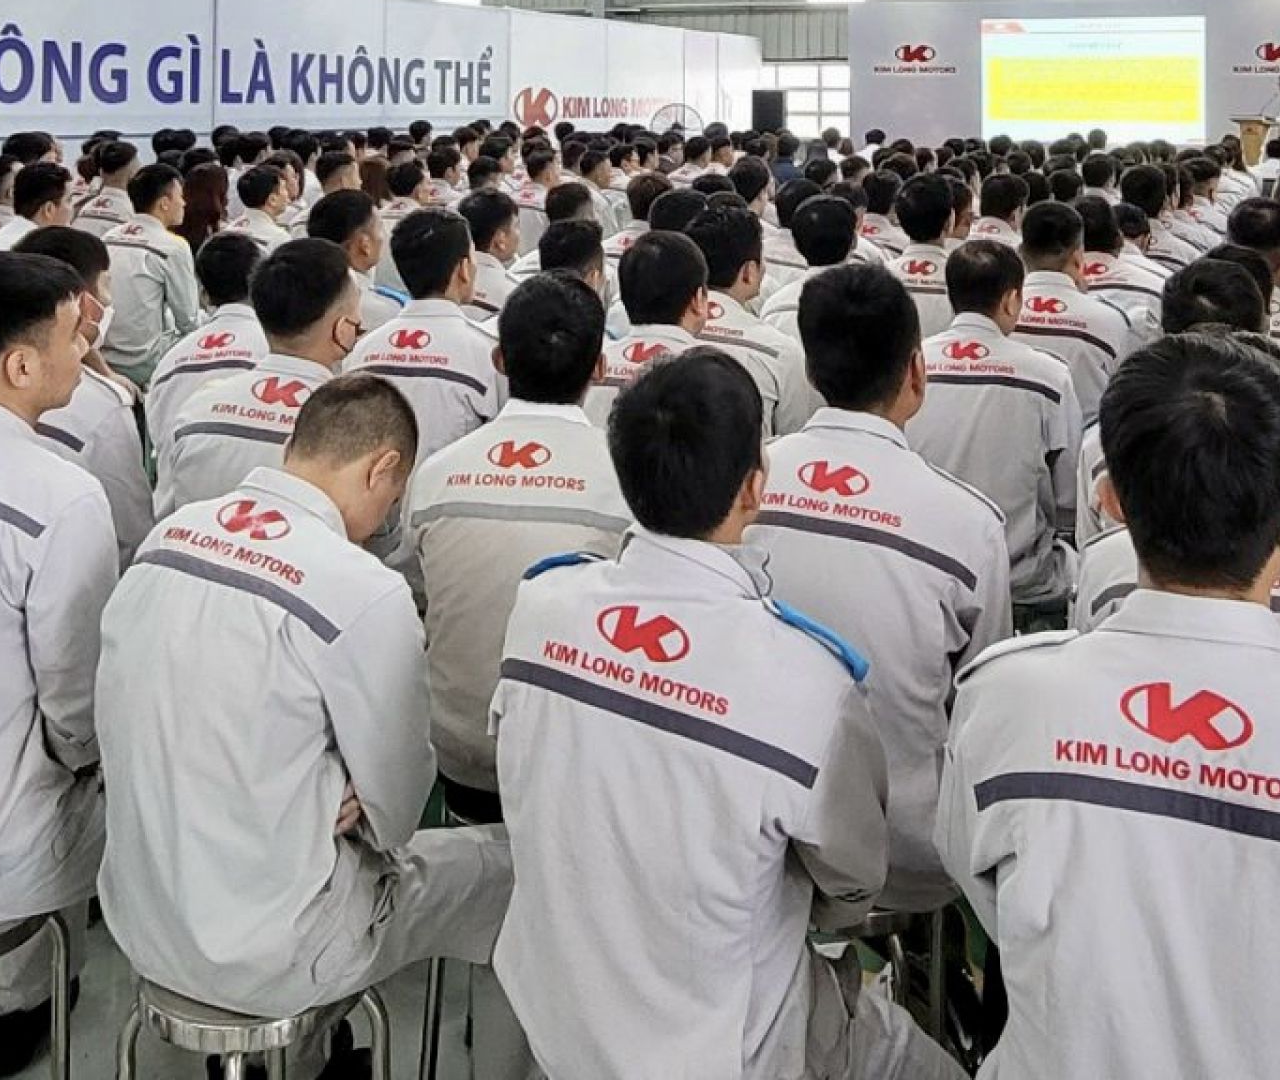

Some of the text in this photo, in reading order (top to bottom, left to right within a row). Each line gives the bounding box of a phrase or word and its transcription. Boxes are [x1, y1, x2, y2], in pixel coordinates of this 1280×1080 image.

[147, 33, 201, 104] GÌ
[220, 38, 275, 104] LÀ
[290, 44, 425, 105] KHÔNG
[434, 45, 492, 105] THỂ
[563, 96, 590, 118] KIM
[593, 96, 628, 118] LONG
[446, 473, 586, 492] KIM LONG MOTORS
[787, 494, 829, 513] LONG
[832, 502, 903, 528] MOTORS
[163, 527, 305, 586] KIM LONG MOTORS
[543, 640, 729, 716] KIM LONG MOTORS
[1055, 739, 1108, 765] KIM
[1116, 747, 1191, 780] LONG
